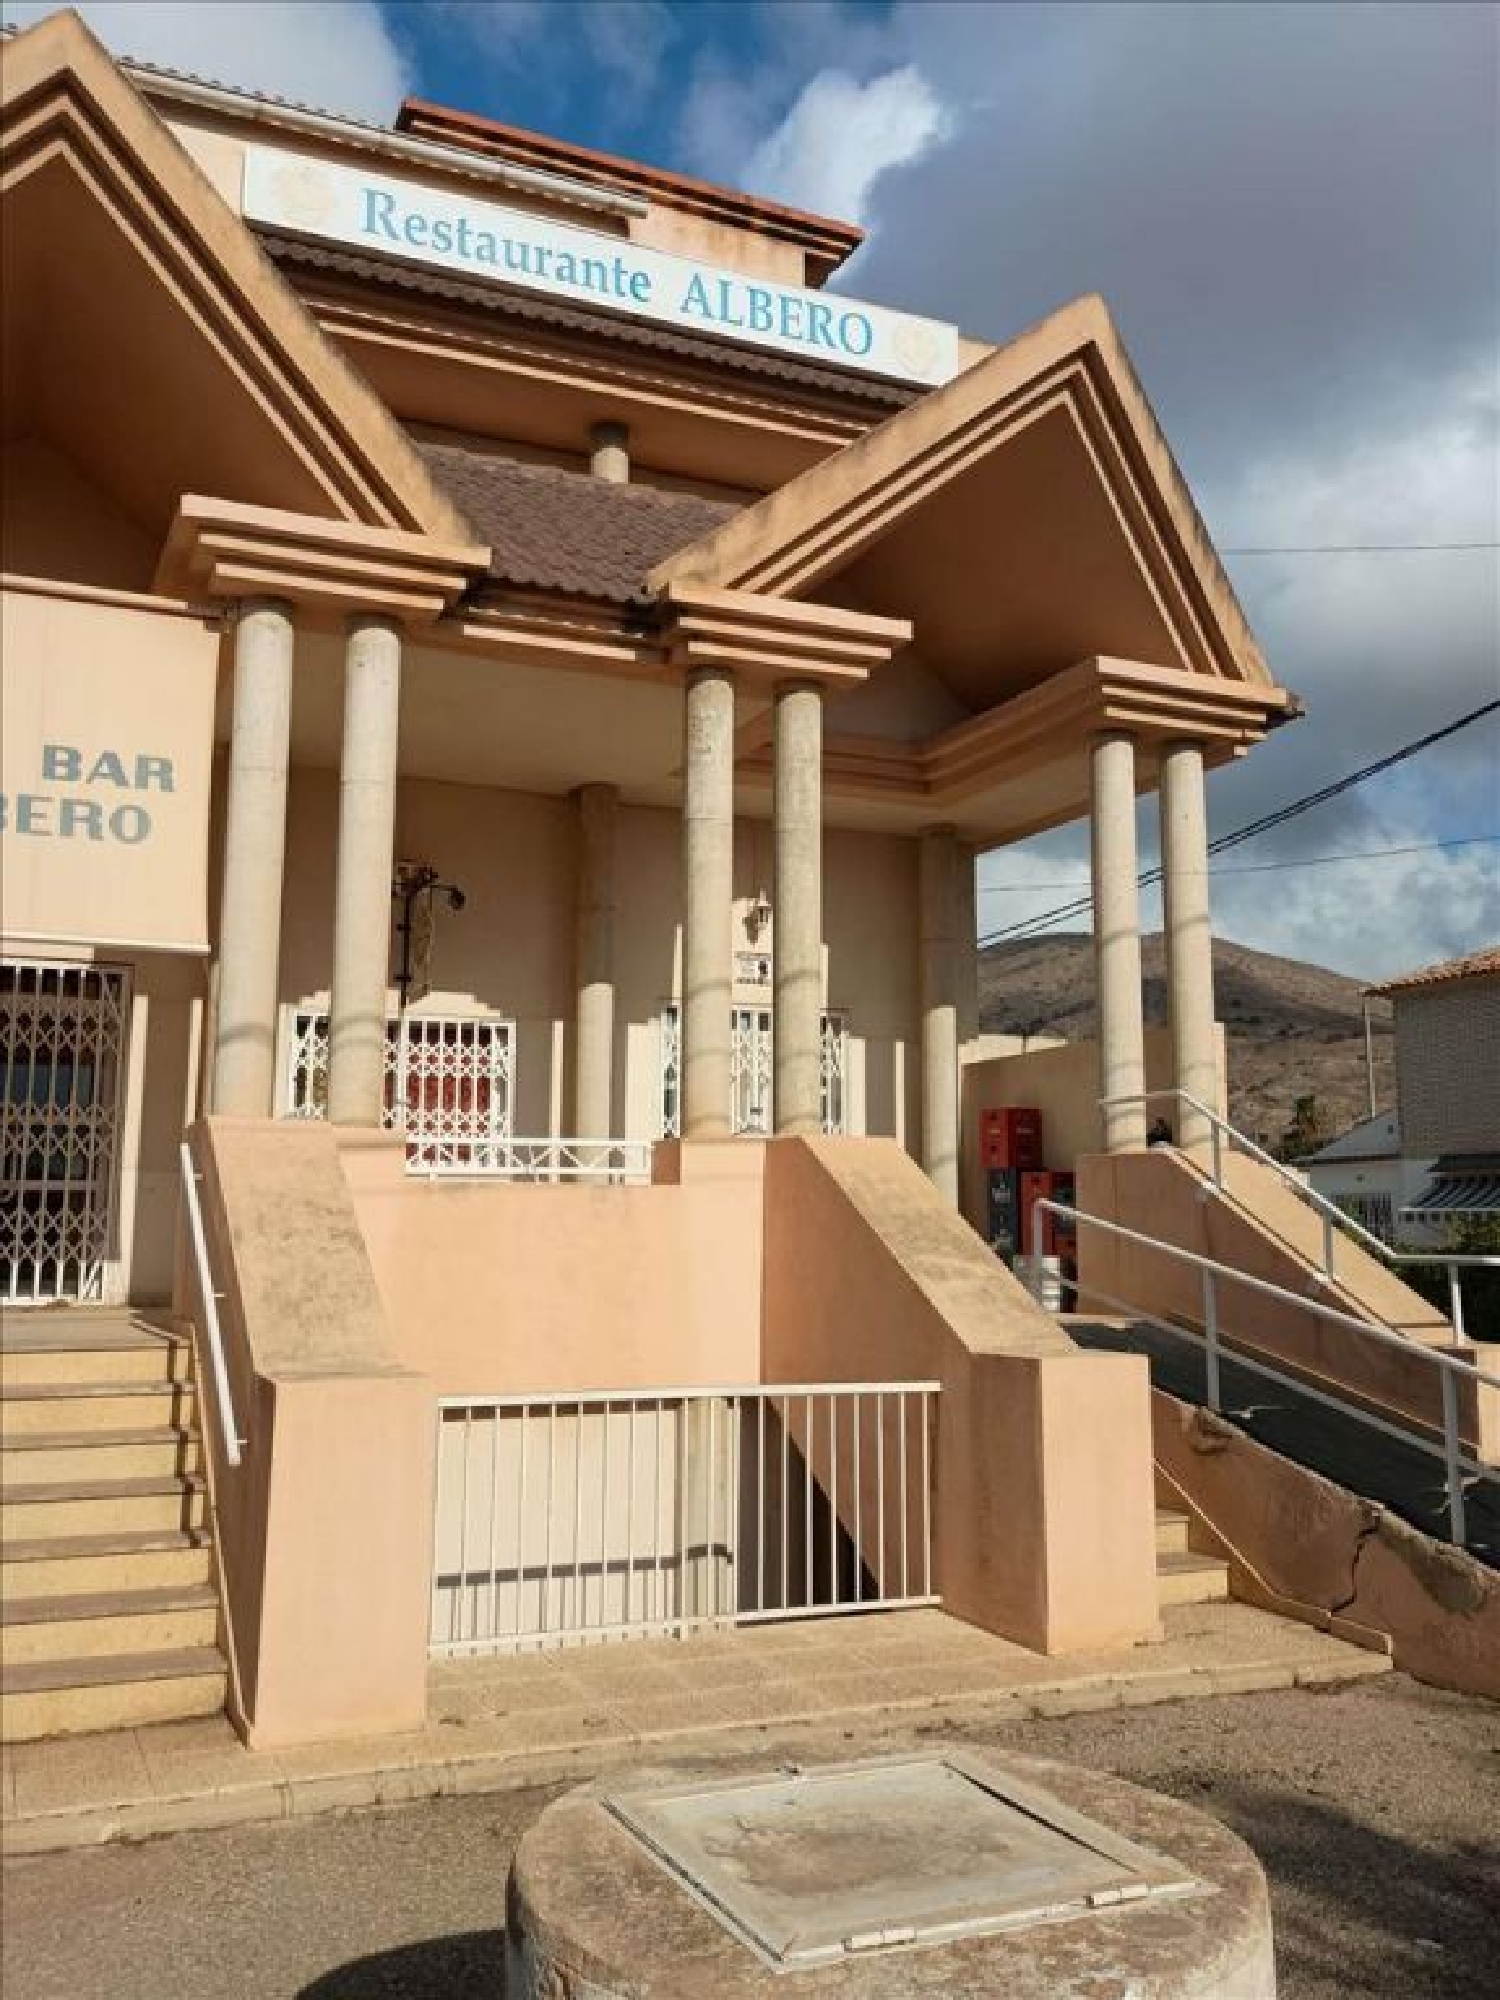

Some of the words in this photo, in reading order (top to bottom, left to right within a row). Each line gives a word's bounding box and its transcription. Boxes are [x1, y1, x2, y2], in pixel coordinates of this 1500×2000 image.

[361, 187, 652, 302] Restaurante
[680, 272, 873, 355] ALBERO
[42, 744, 175, 792] BAR
[0, 793, 151, 844] ERO
